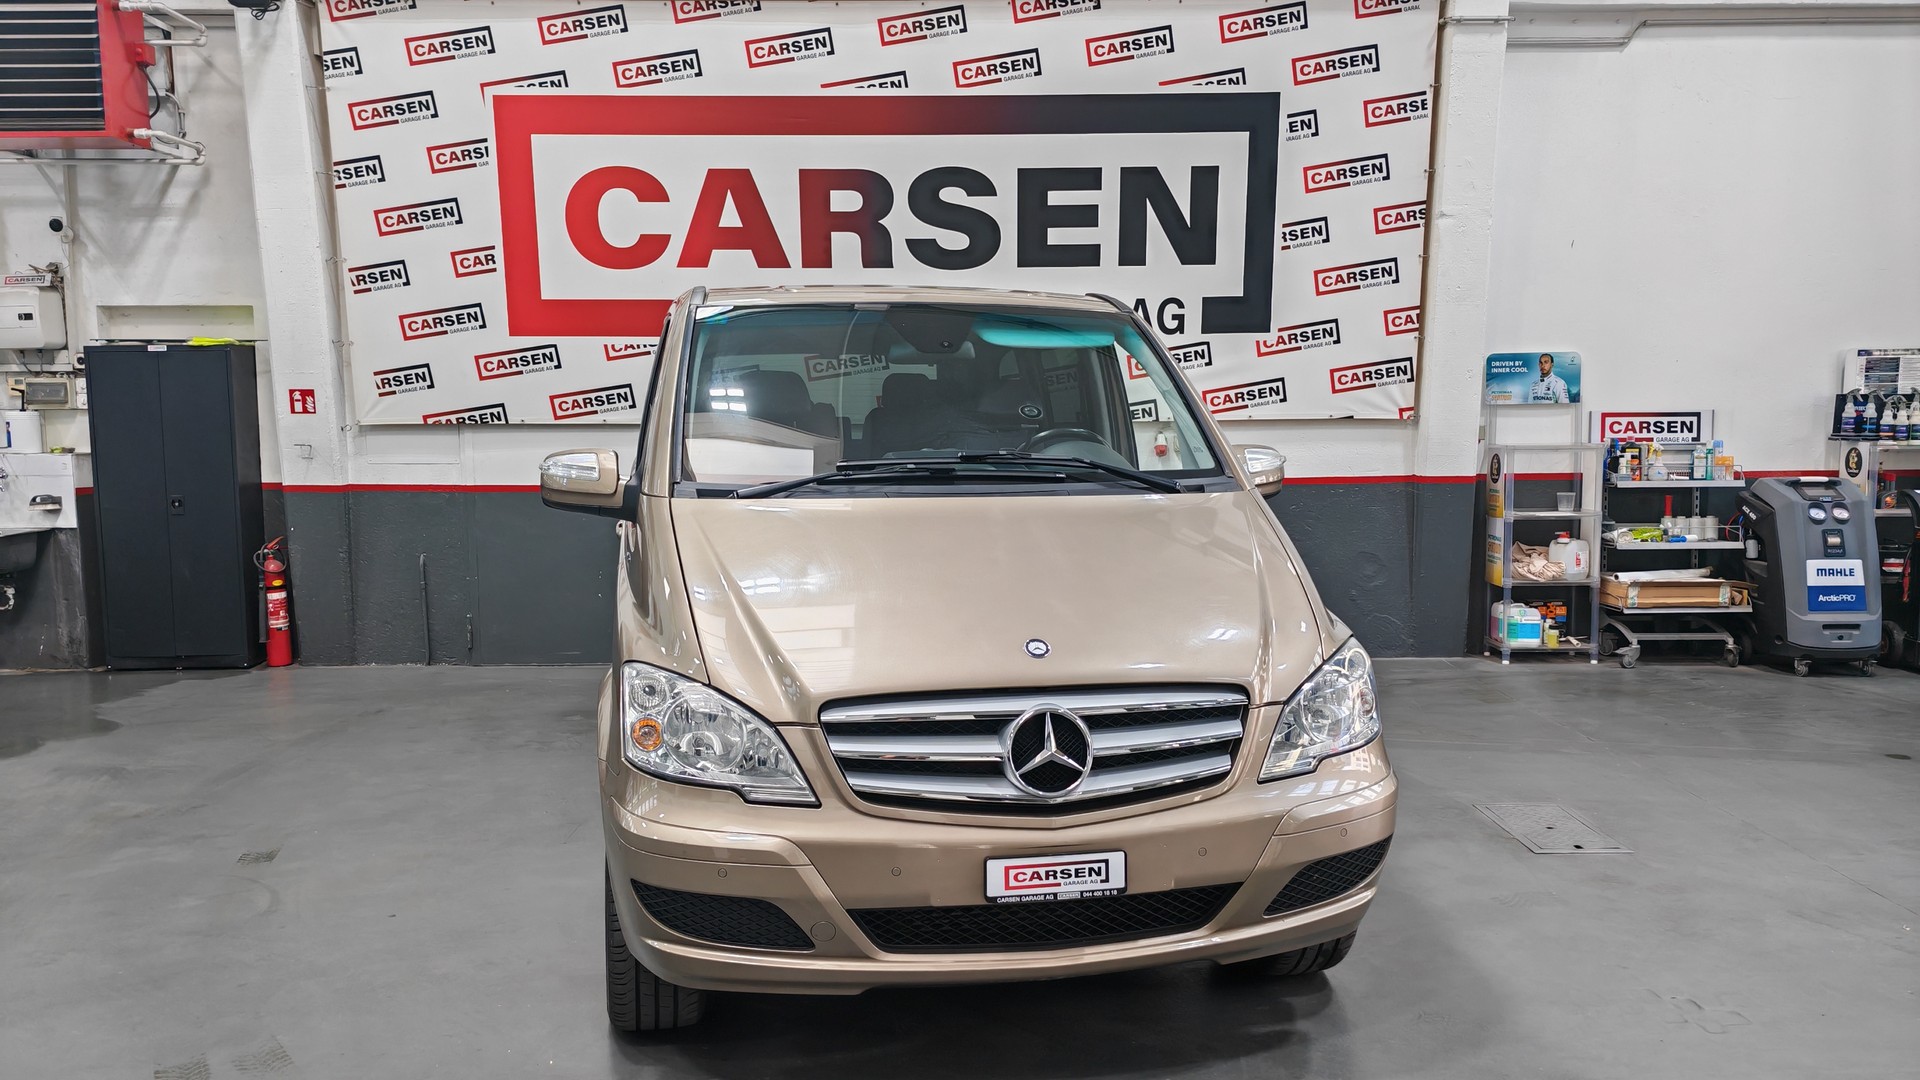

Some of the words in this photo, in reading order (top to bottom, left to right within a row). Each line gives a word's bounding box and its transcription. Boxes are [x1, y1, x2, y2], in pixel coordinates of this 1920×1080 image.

[378, 7, 399, 15] GARAGE
[547, 13, 620, 36] CARSEN
[886, 14, 960, 37] CARSEN
[1227, 10, 1301, 34] CARSEN
[1270, 27, 1290, 35] GARAGE
[414, 35, 487, 57] CARSEN
[754, 37, 827, 59] CARSEN
[1094, 34, 1167, 57] CARSEN
[1136, 51, 1157, 59] GARAGE
[796, 53, 817, 61] GARAGE
[1300, 53, 1372, 76] CARSEN
[621, 58, 695, 80] CARSEN
[961, 57, 1034, 80] CARSEN
[1004, 74, 1024, 82] GARAGE
[357, 99, 431, 121] CARSEN
[401, 116, 421, 124] GARAGE
[1286, 119, 1312, 133] EN
[1311, 162, 1383, 184] CARSEN
[348, 180, 368, 188] GARAGE
[383, 206, 455, 227] CARSEN
[426, 222, 446, 230] GARAGE
[565, 164, 1219, 271] CARSEN
[460, 253, 496, 269] CAR
[1322, 266, 1392, 287] CARSEN
[408, 311, 479, 332] CARSEN
[1133, 298, 1185, 335] AG
[1303, 342, 1323, 350] GARAGE
[483, 352, 554, 372] CARSEN
[813, 354, 883, 373] CARSEN
[1337, 365, 1407, 385] CARSEN
[558, 391, 628, 411] CARSEN
[1210, 385, 1280, 407] CARSEN
[1609, 421, 1693, 434] CARSEN
[1817, 568, 1855, 577] MAHLE
[1013, 866, 1101, 883] CARSEN
